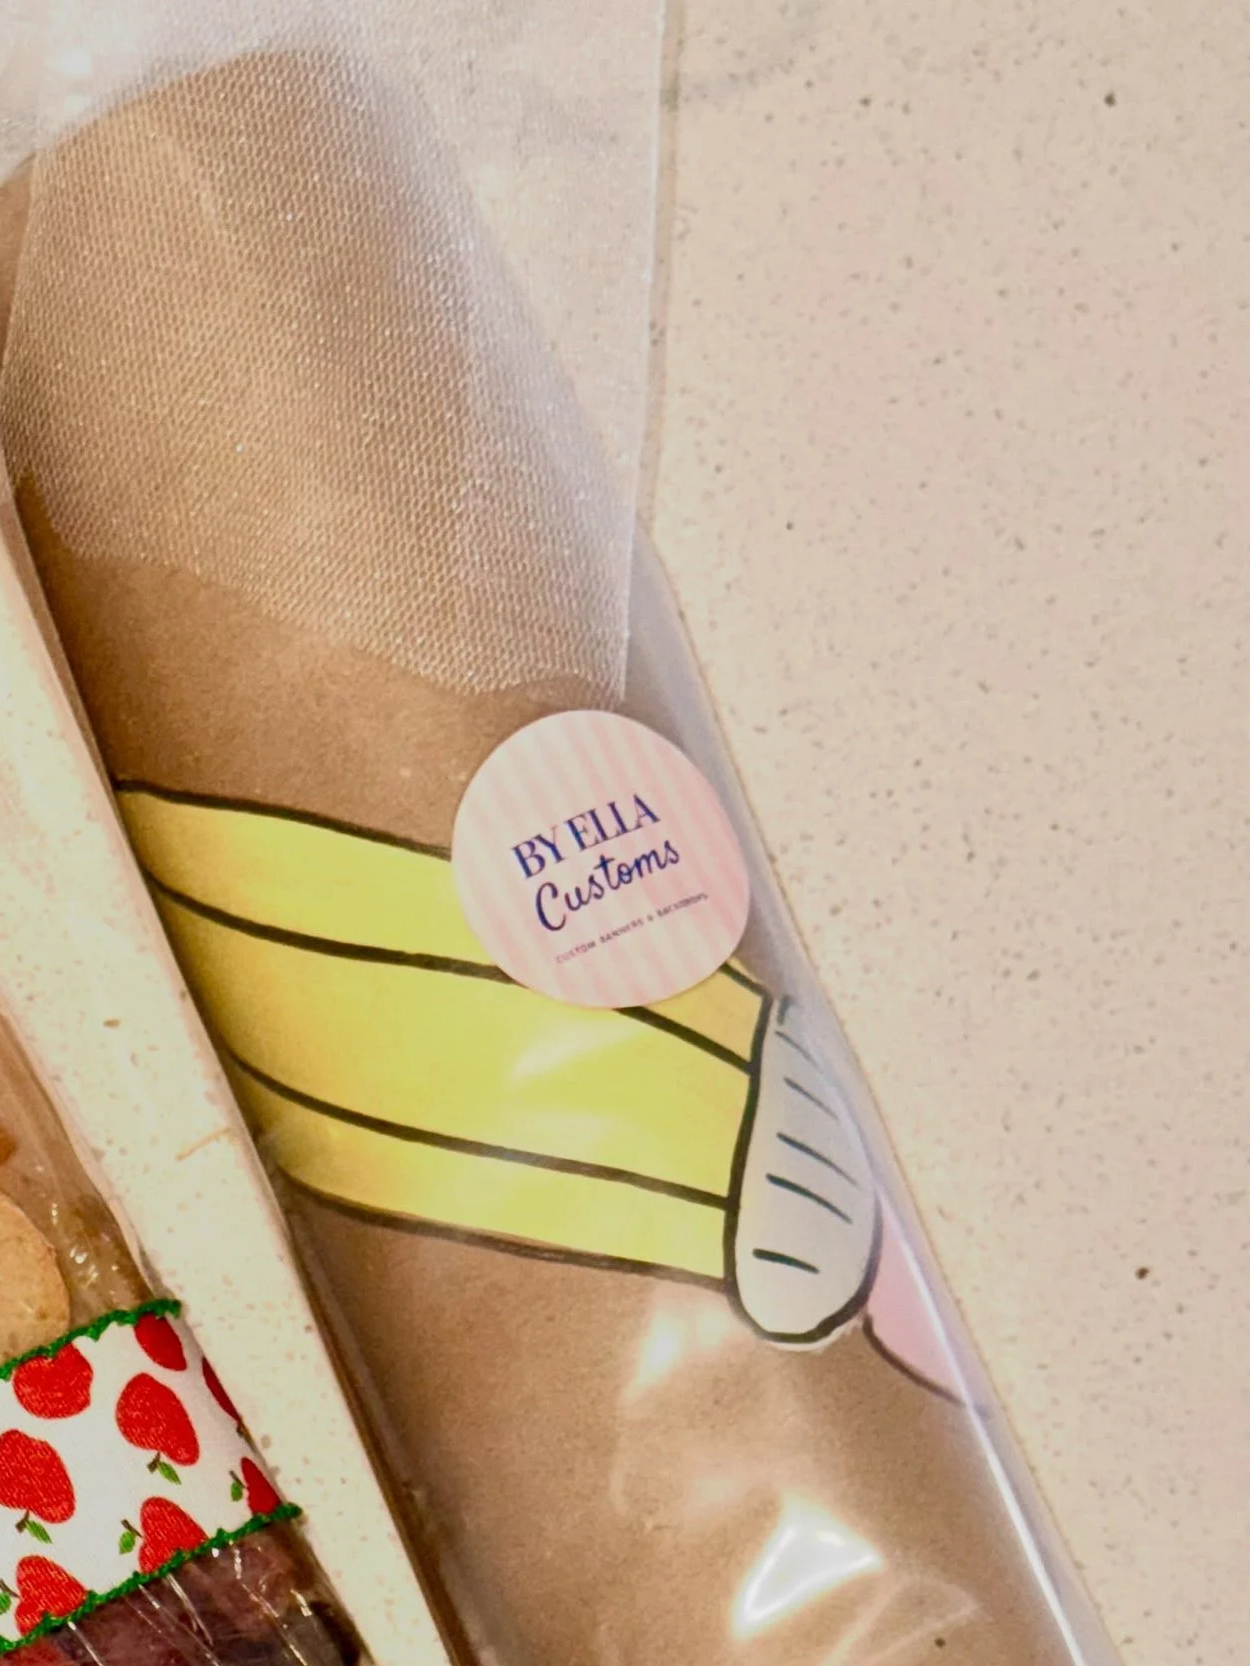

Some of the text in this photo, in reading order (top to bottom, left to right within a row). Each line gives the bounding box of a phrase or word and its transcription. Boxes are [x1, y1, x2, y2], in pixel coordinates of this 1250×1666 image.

[512, 794, 660, 879] BY ELLA
[535, 840, 680, 932] Customs
